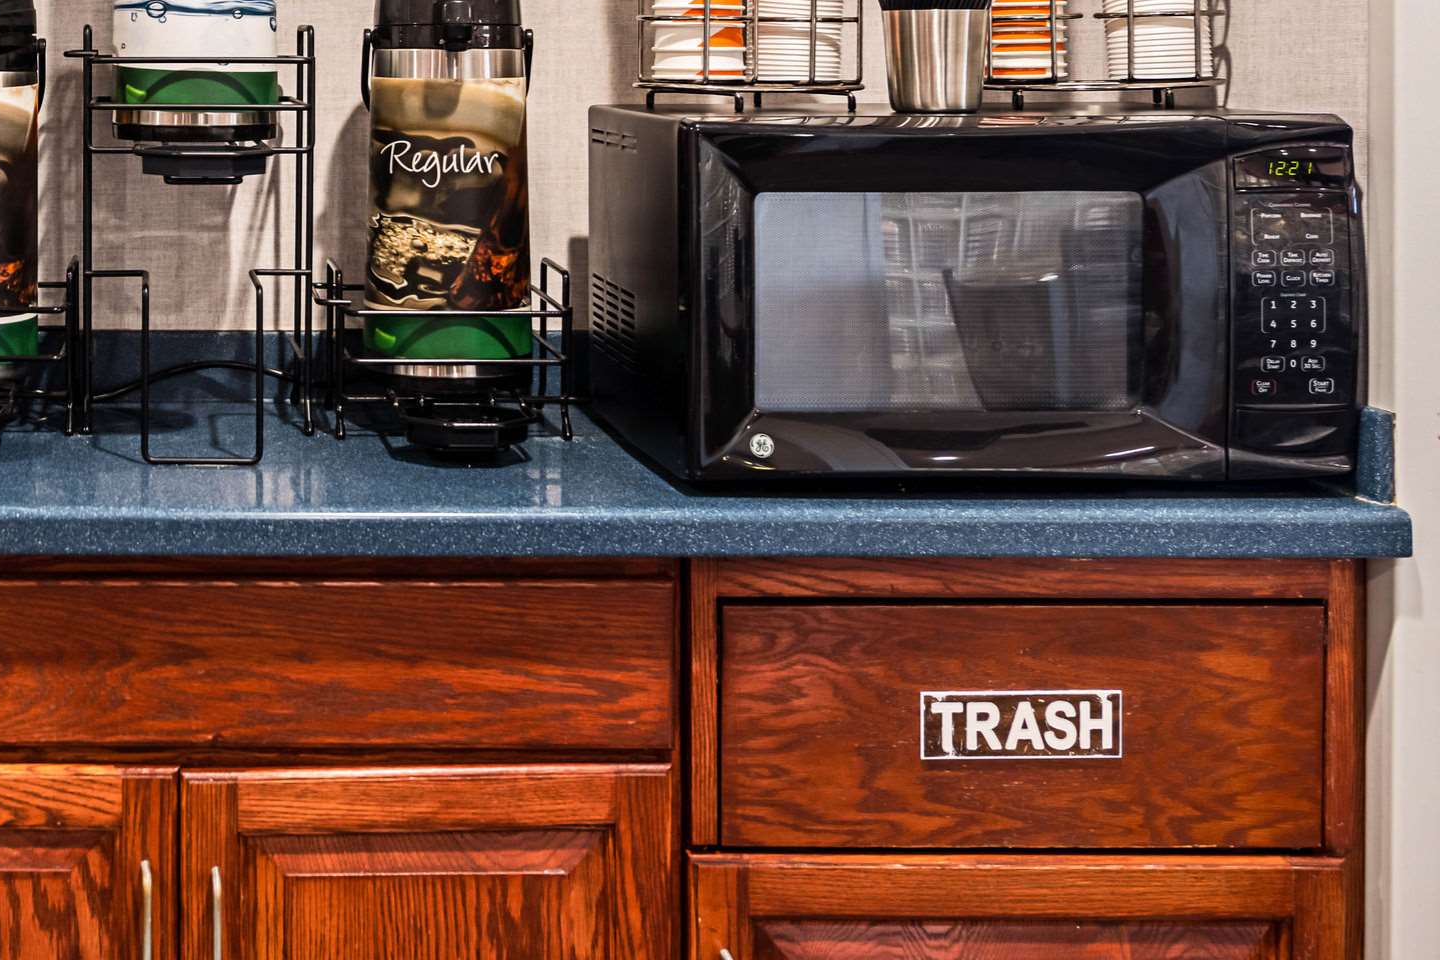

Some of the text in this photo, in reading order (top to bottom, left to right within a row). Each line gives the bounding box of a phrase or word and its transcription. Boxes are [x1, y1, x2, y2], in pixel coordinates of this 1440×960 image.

[380, 140, 499, 188] Regular
[1270, 300, 1277, 309] 1
[1290, 300, 1297, 309] 2
[1310, 300, 1317, 309] 3
[1270, 320, 1277, 329] 4
[1290, 320, 1297, 329] 5
[1310, 320, 1317, 329] 6
[1270, 340, 1277, 349] 7
[1290, 340, 1297, 349] 8
[1310, 340, 1317, 349] 9
[930, 700, 1113, 752] TRASH
